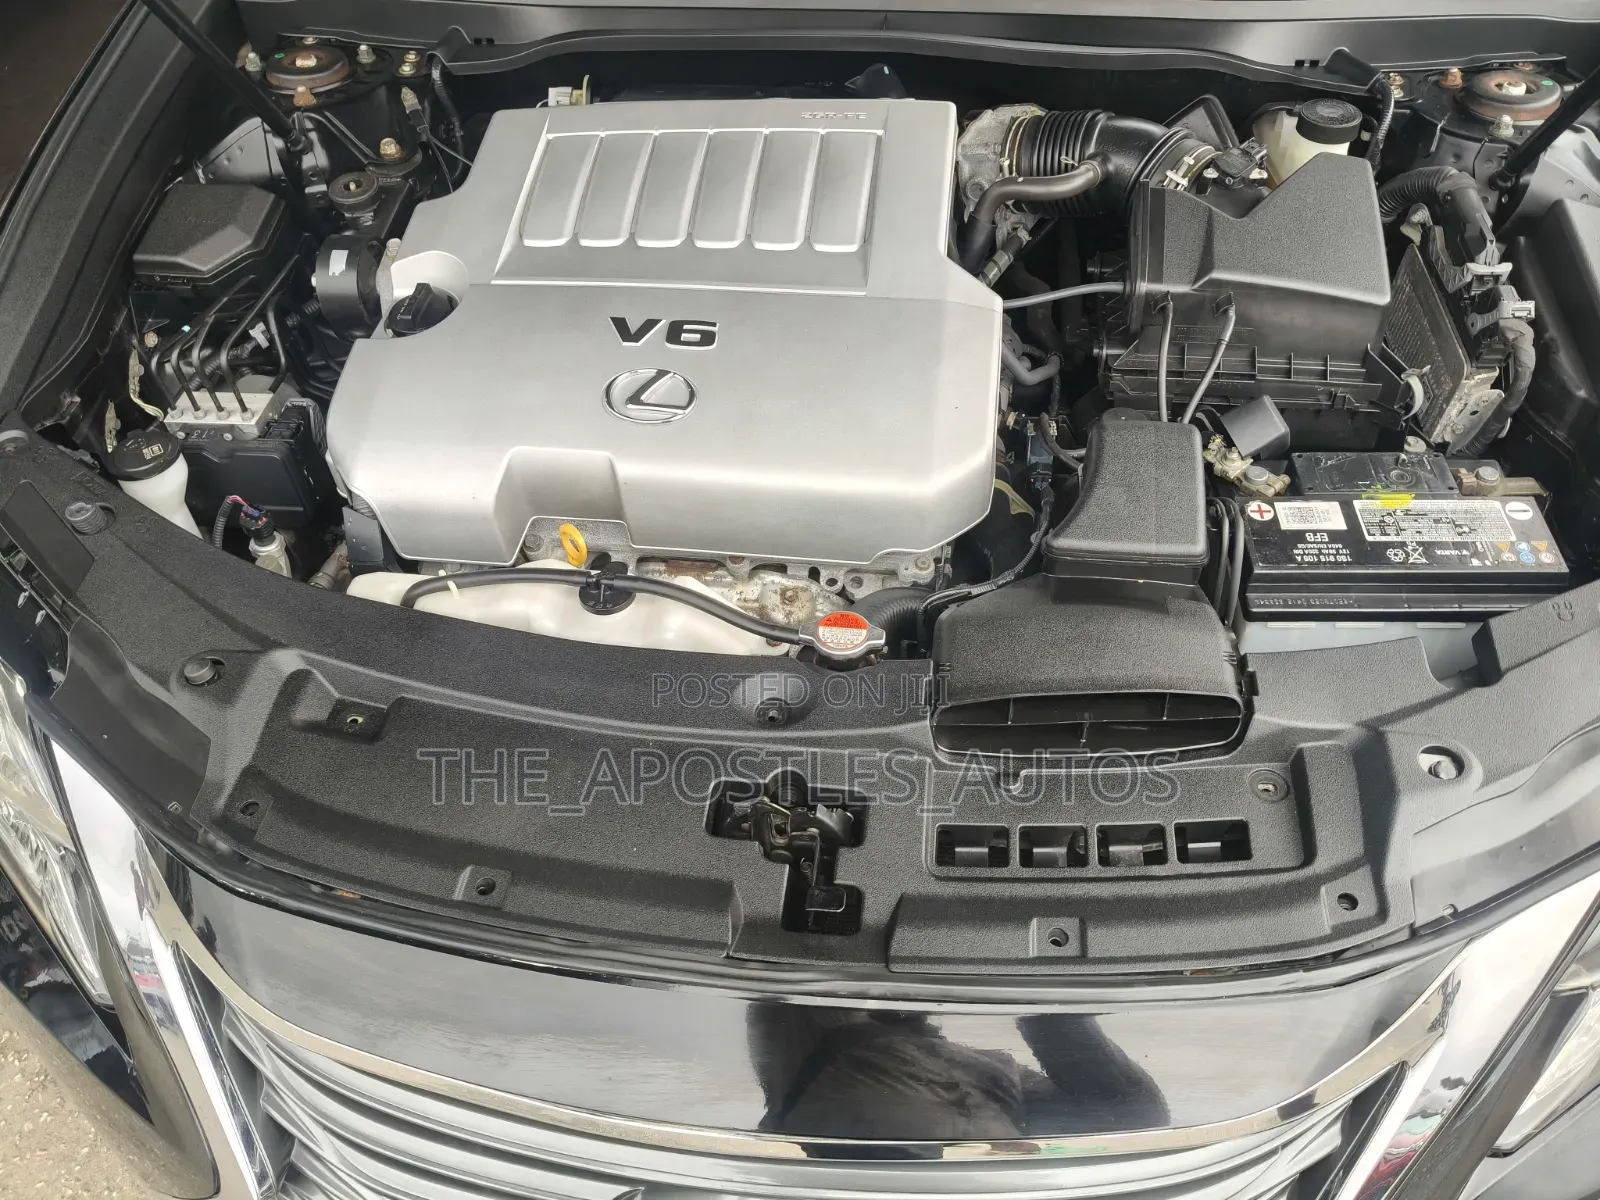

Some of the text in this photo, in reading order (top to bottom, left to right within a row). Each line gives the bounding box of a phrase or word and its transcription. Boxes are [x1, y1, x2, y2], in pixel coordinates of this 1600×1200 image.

[801, 111, 868, 119] 2GR-FE
[608, 316, 720, 351] V6
[1305, 532, 1329, 542] EFB
